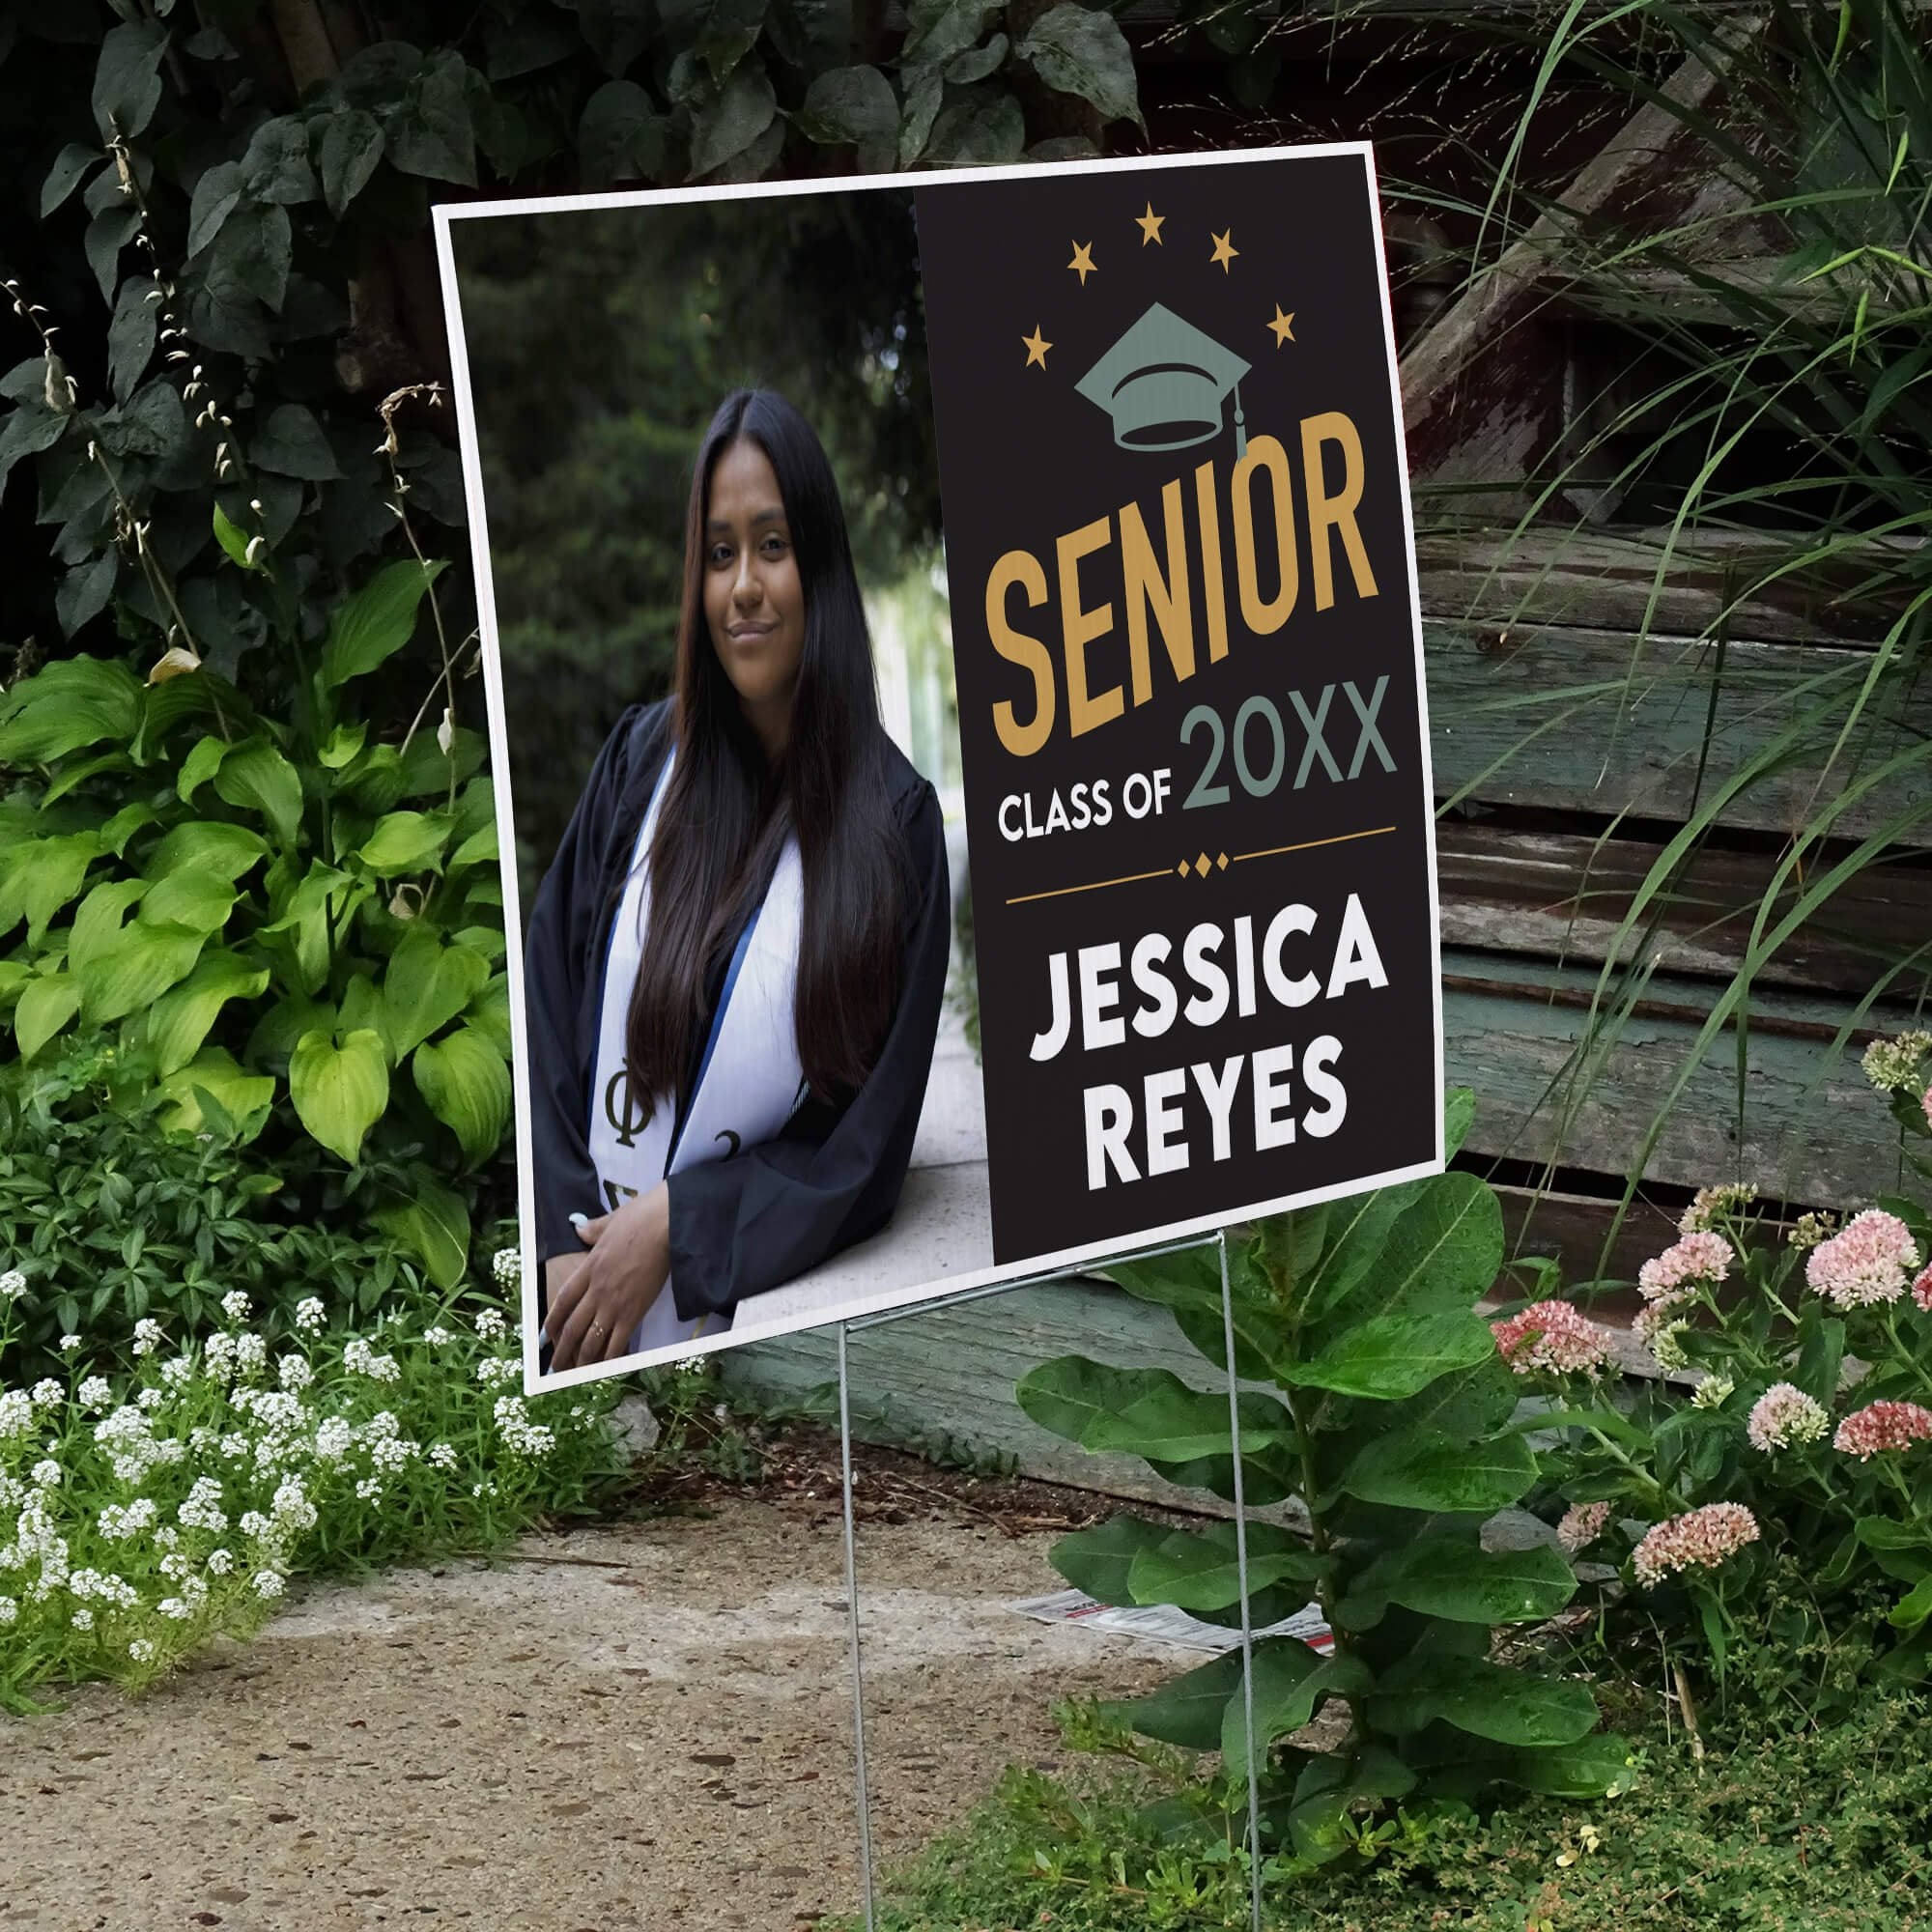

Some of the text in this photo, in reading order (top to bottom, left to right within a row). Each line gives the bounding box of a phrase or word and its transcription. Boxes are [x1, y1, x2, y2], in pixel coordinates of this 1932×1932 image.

[985, 412, 1378, 756] SENIOR
[998, 675, 1397, 841] CLASS OF 20XX
[1030, 893, 1389, 1061] JESSICA
[1084, 1036, 1347, 1190] REYES
